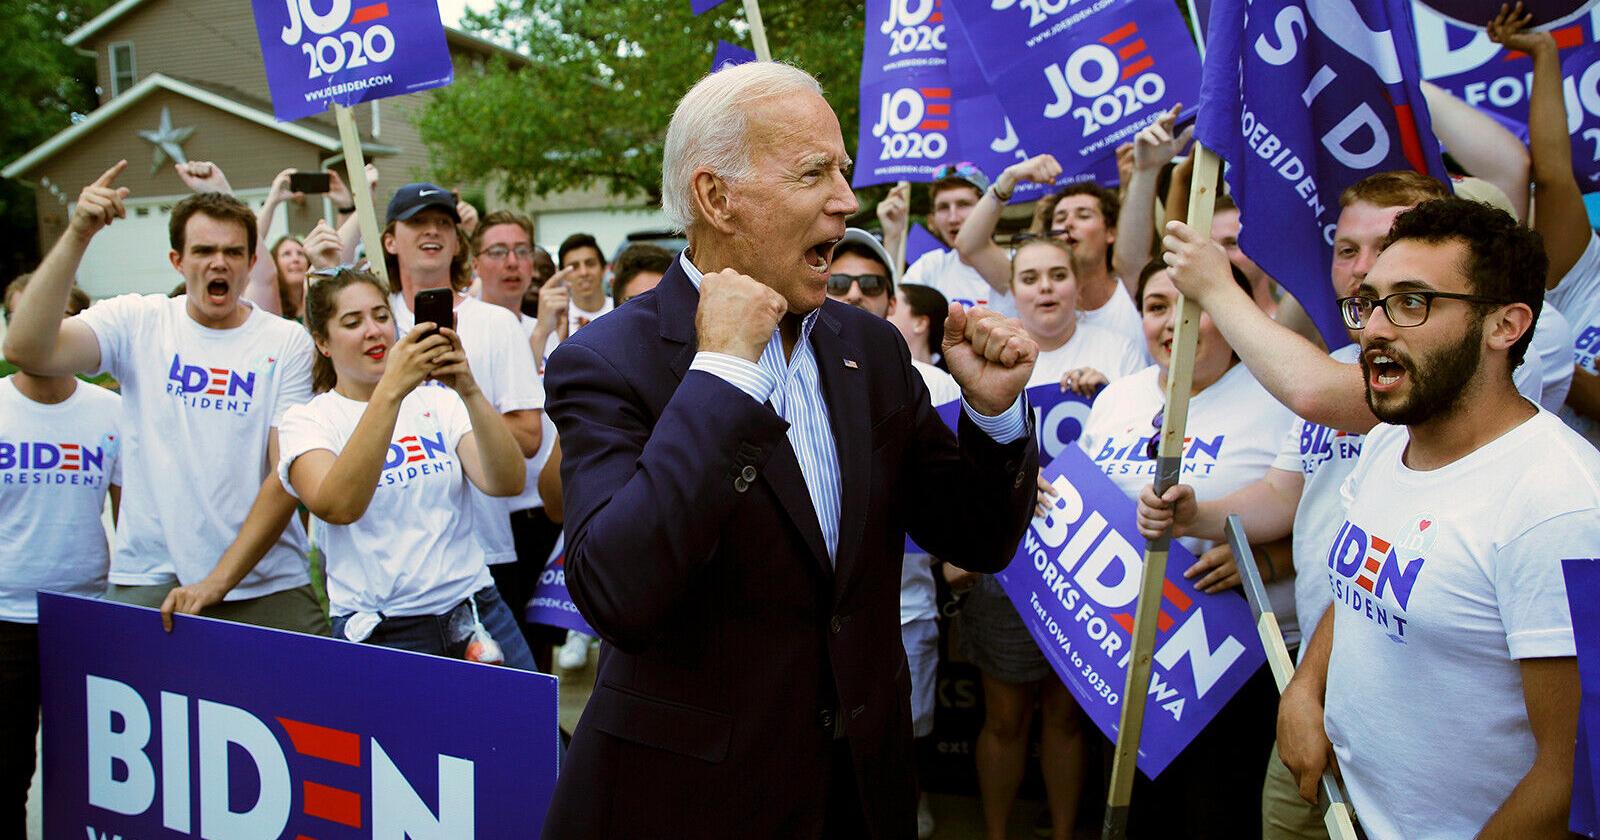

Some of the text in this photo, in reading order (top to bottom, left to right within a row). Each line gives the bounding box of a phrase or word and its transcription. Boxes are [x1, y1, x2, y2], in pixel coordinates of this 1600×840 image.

[302, 25, 395, 79] 2020
[1044, 22, 1155, 118] JOE
[872, 88, 951, 137] JOE
[1072, 73, 1166, 137] 2020
[1464, 76, 1534, 108] FO
[880, 132, 948, 160] 2020
[1079, 108, 1168, 157] WWW.JOEBIDEN.CO
[1240, 104, 1337, 246] OEBIDEN.C
[0, 442, 104, 471] BIDEN
[1094, 435, 1225, 461] BIDN
[4, 472, 104, 486] RESIDENT
[377, 460, 453, 488] SIDENT
[1024, 528, 1081, 611] WORKS
[1074, 602, 1123, 658] FOR
[1117, 650, 1186, 722] IWA
[1030, 591, 1048, 621] Text
[1045, 616, 1072, 655] IOWA
[1070, 650, 1083, 668] to
[1081, 664, 1120, 706] 30330
[86, 674, 475, 840] BIDEN
